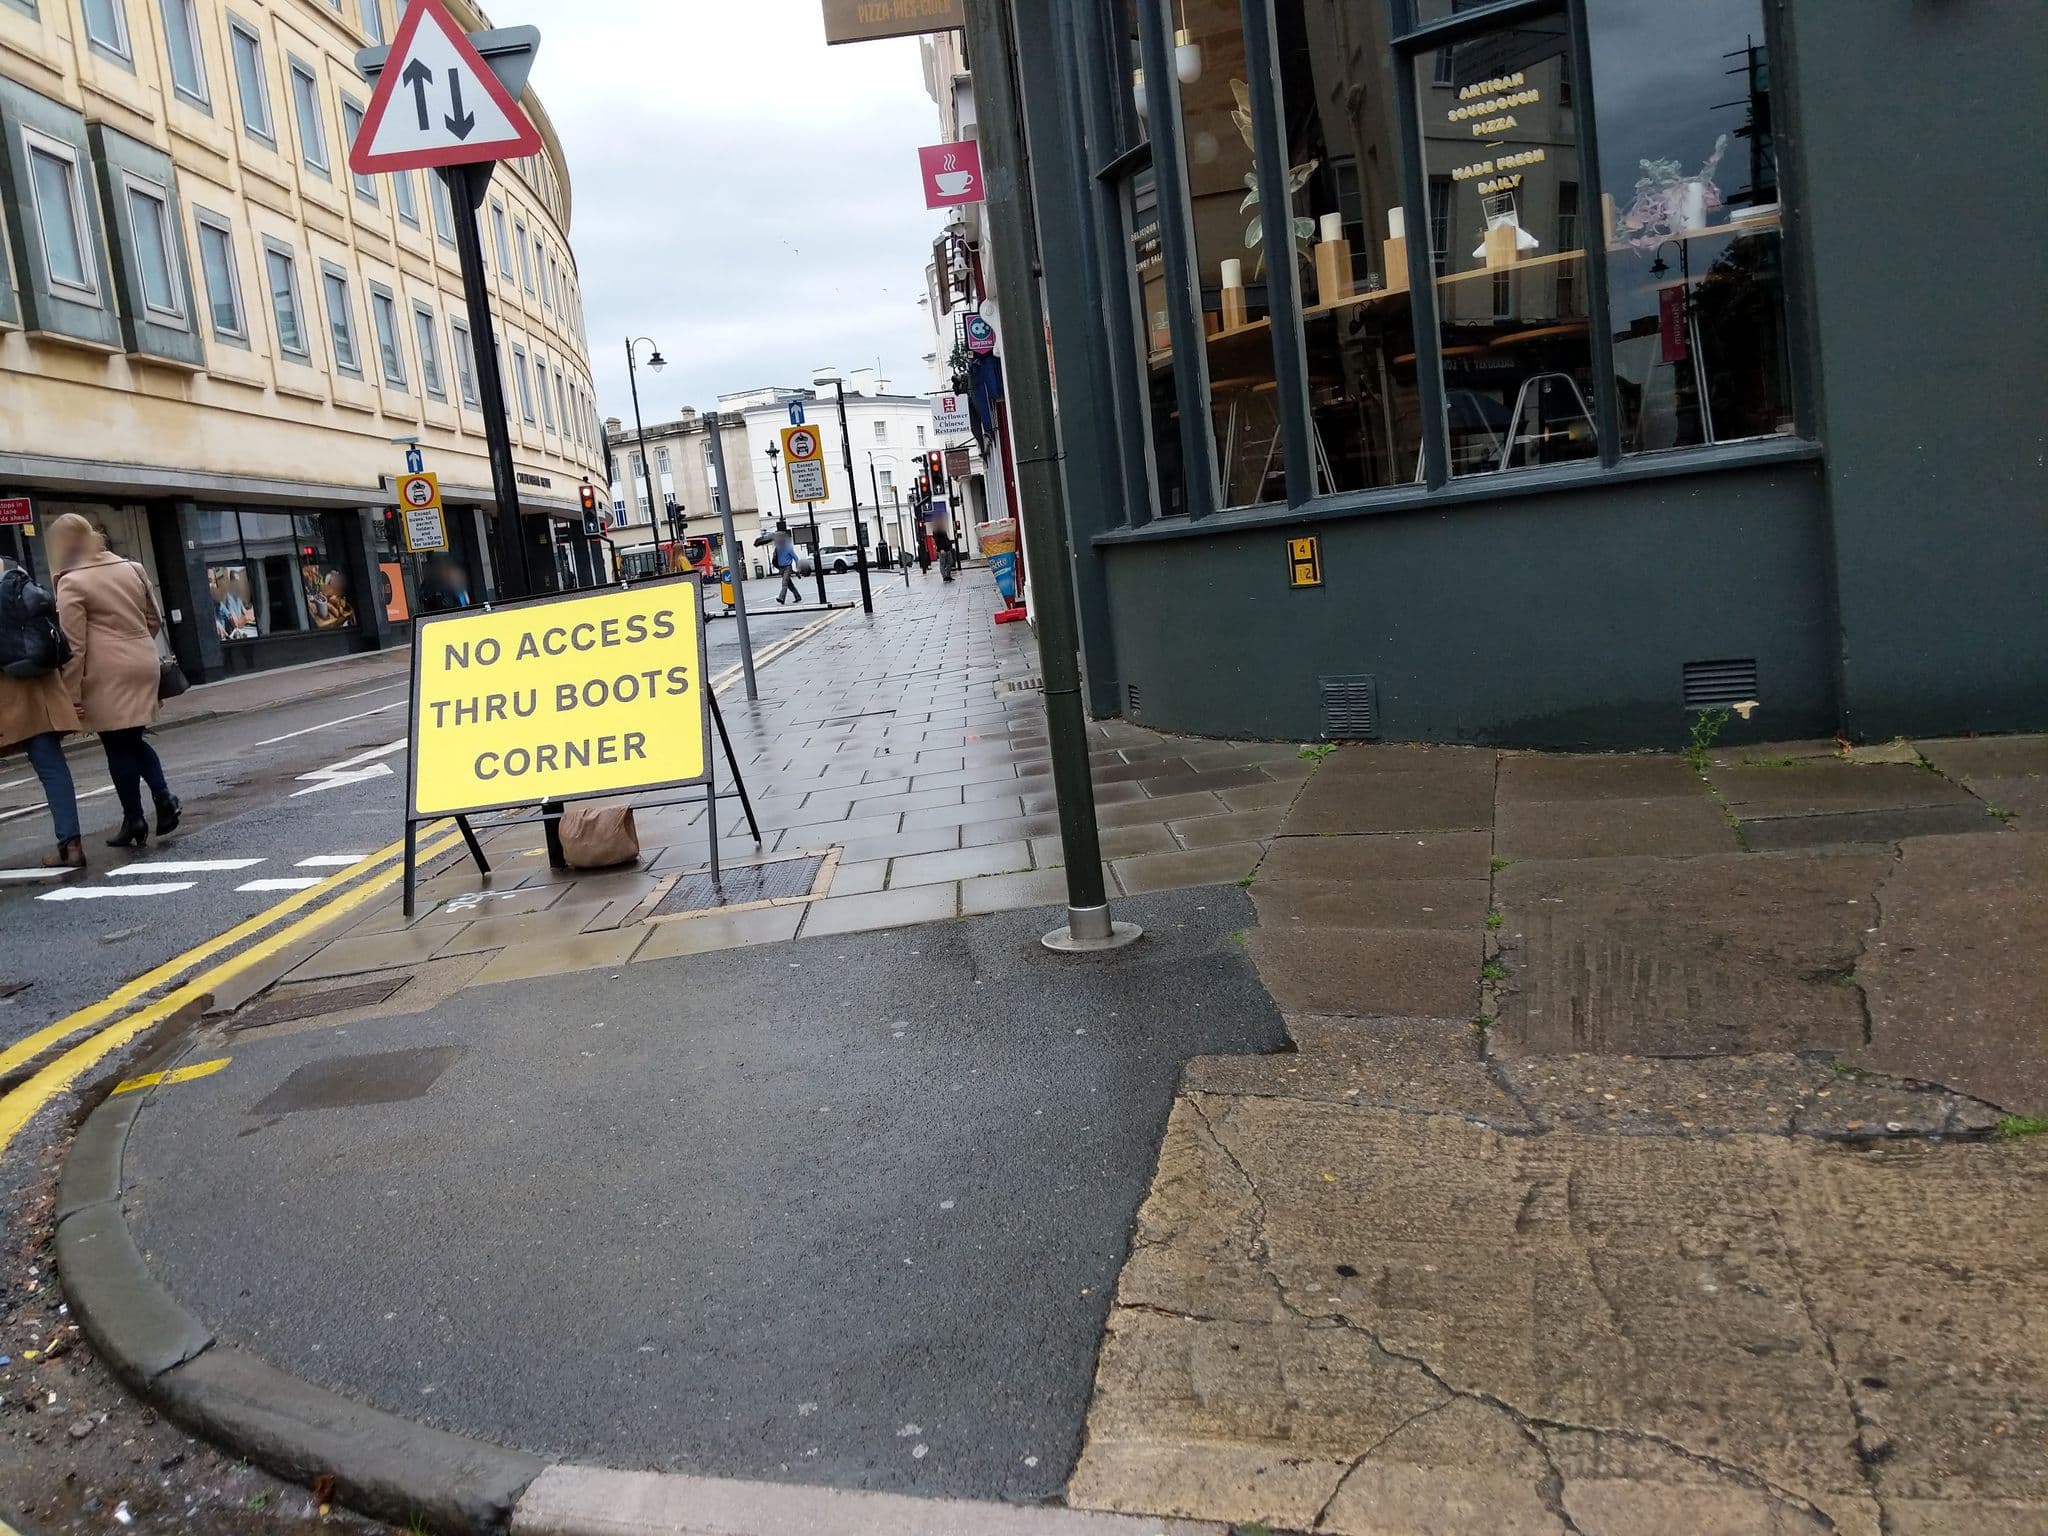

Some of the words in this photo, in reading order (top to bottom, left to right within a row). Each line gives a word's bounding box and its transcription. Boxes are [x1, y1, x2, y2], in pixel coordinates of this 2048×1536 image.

[1459, 72, 1524, 99] ARTISAN
[1448, 89, 1539, 121] SOURDOUGH
[1472, 115, 1518, 136] PIZZA
[1452, 161, 1494, 180] MADE
[1496, 148, 1545, 170] FRESH
[1478, 173, 1521, 194] DAILY
[933, 413, 968, 422] Mayflower
[935, 426, 970, 435] Restaurant
[1299, 544, 1305, 554] 4
[1305, 567, 1312, 579] 2
[444, 637, 501, 671] NO
[515, 610, 675, 661] ACCESS
[430, 688, 537, 728] THRU
[556, 665, 689, 712] BOOTS
[474, 731, 647, 780] CORNER
